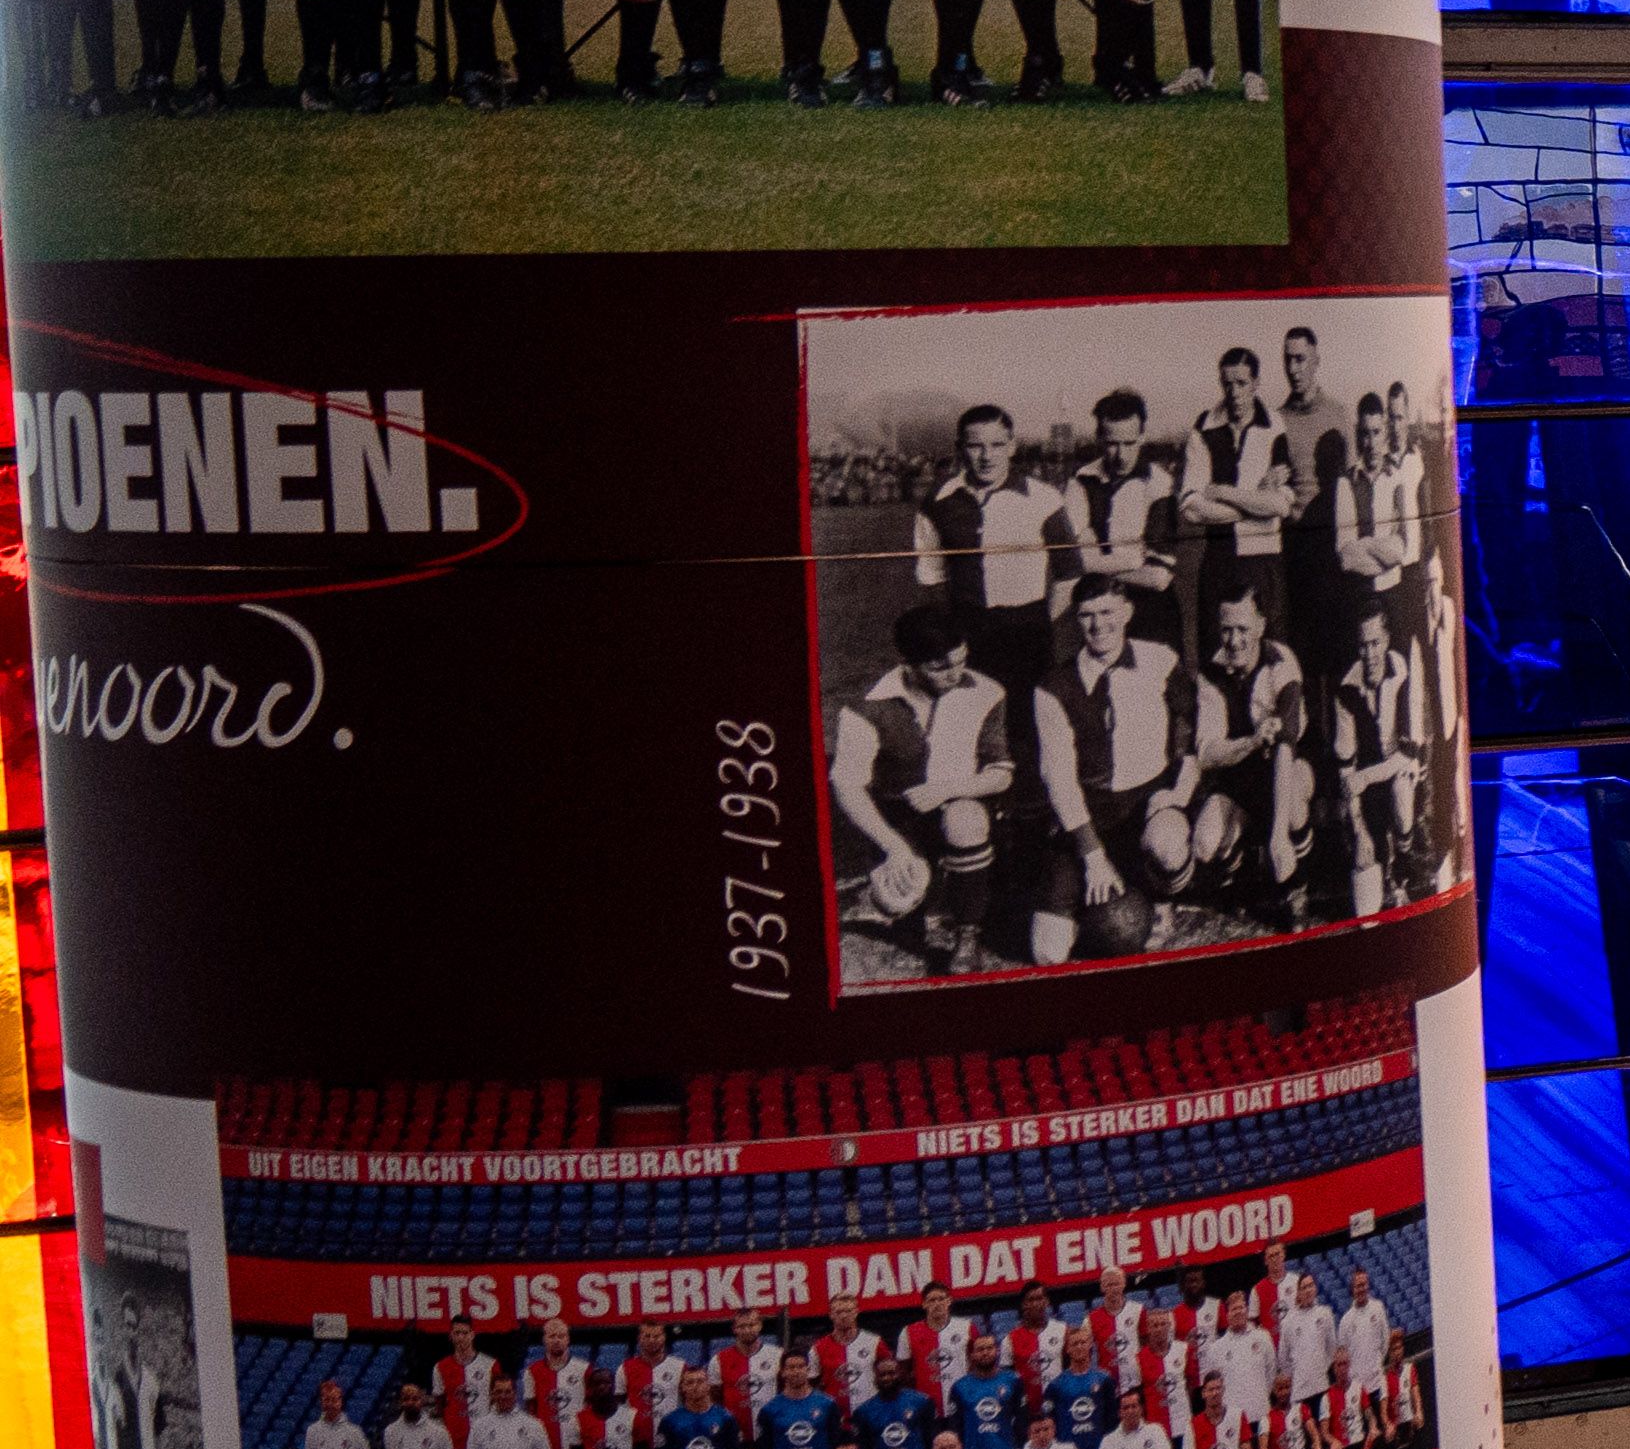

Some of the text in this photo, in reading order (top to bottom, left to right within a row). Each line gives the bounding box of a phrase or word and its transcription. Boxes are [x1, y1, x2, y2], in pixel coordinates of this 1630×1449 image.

[715, 719, 791, 1001] 1937-1938
[247, 1146, 743, 1183] UIT EIGEN KRACHT VOORTGEBRACHT
[917, 1059, 1384, 1158] NIETS IS STERKER DAN DAT ENE WOORD
[368, 1193, 1295, 1321] NIETS IS STERKER DAN DAT ENE WOORD
